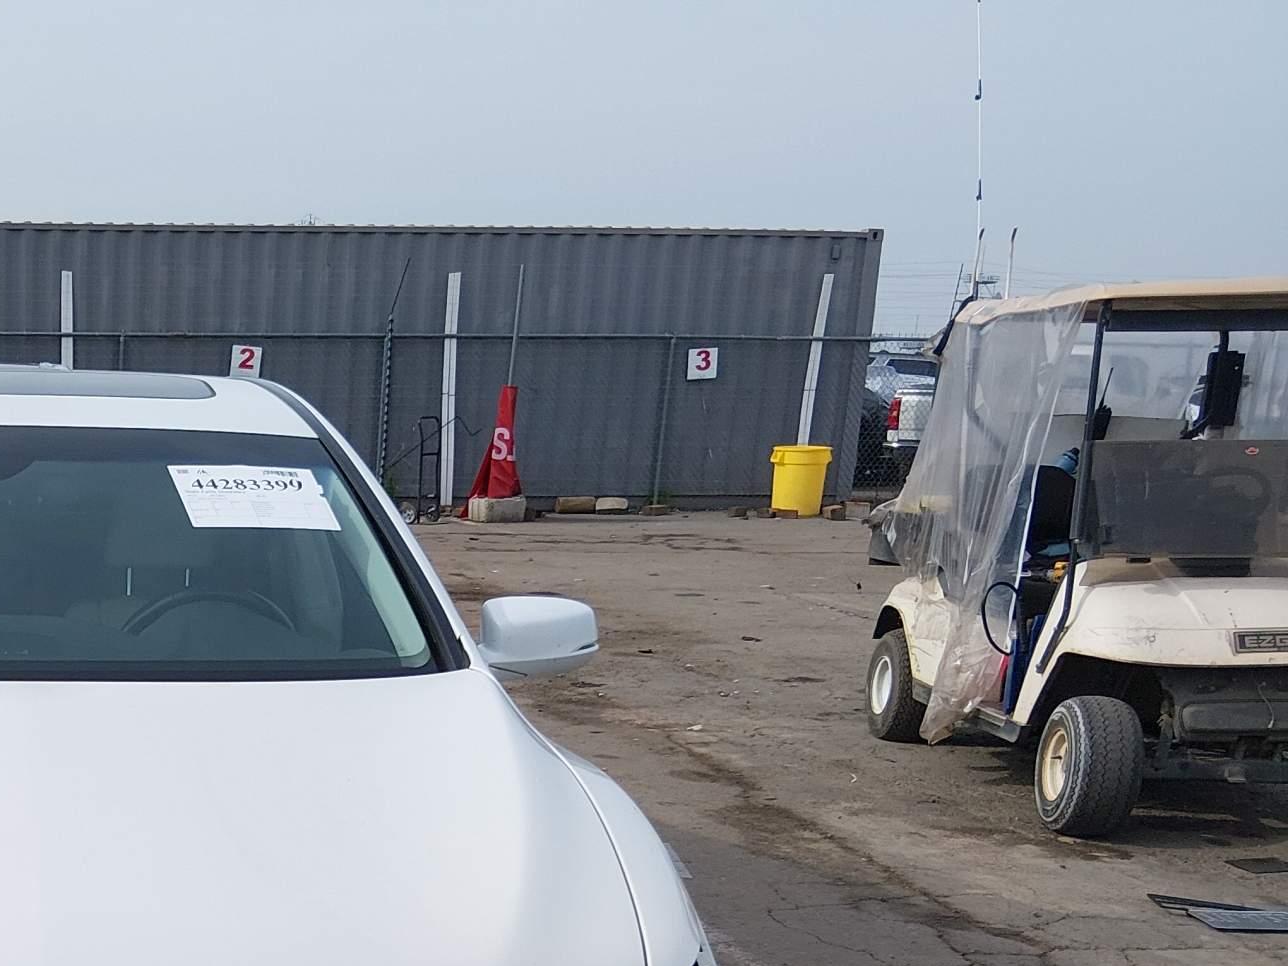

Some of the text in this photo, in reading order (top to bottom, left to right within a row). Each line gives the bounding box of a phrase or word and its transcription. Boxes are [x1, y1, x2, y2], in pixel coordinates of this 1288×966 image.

[238, 348, 255, 370] 2
[695, 350, 711, 371] 3
[191, 478, 303, 492] 44283399
